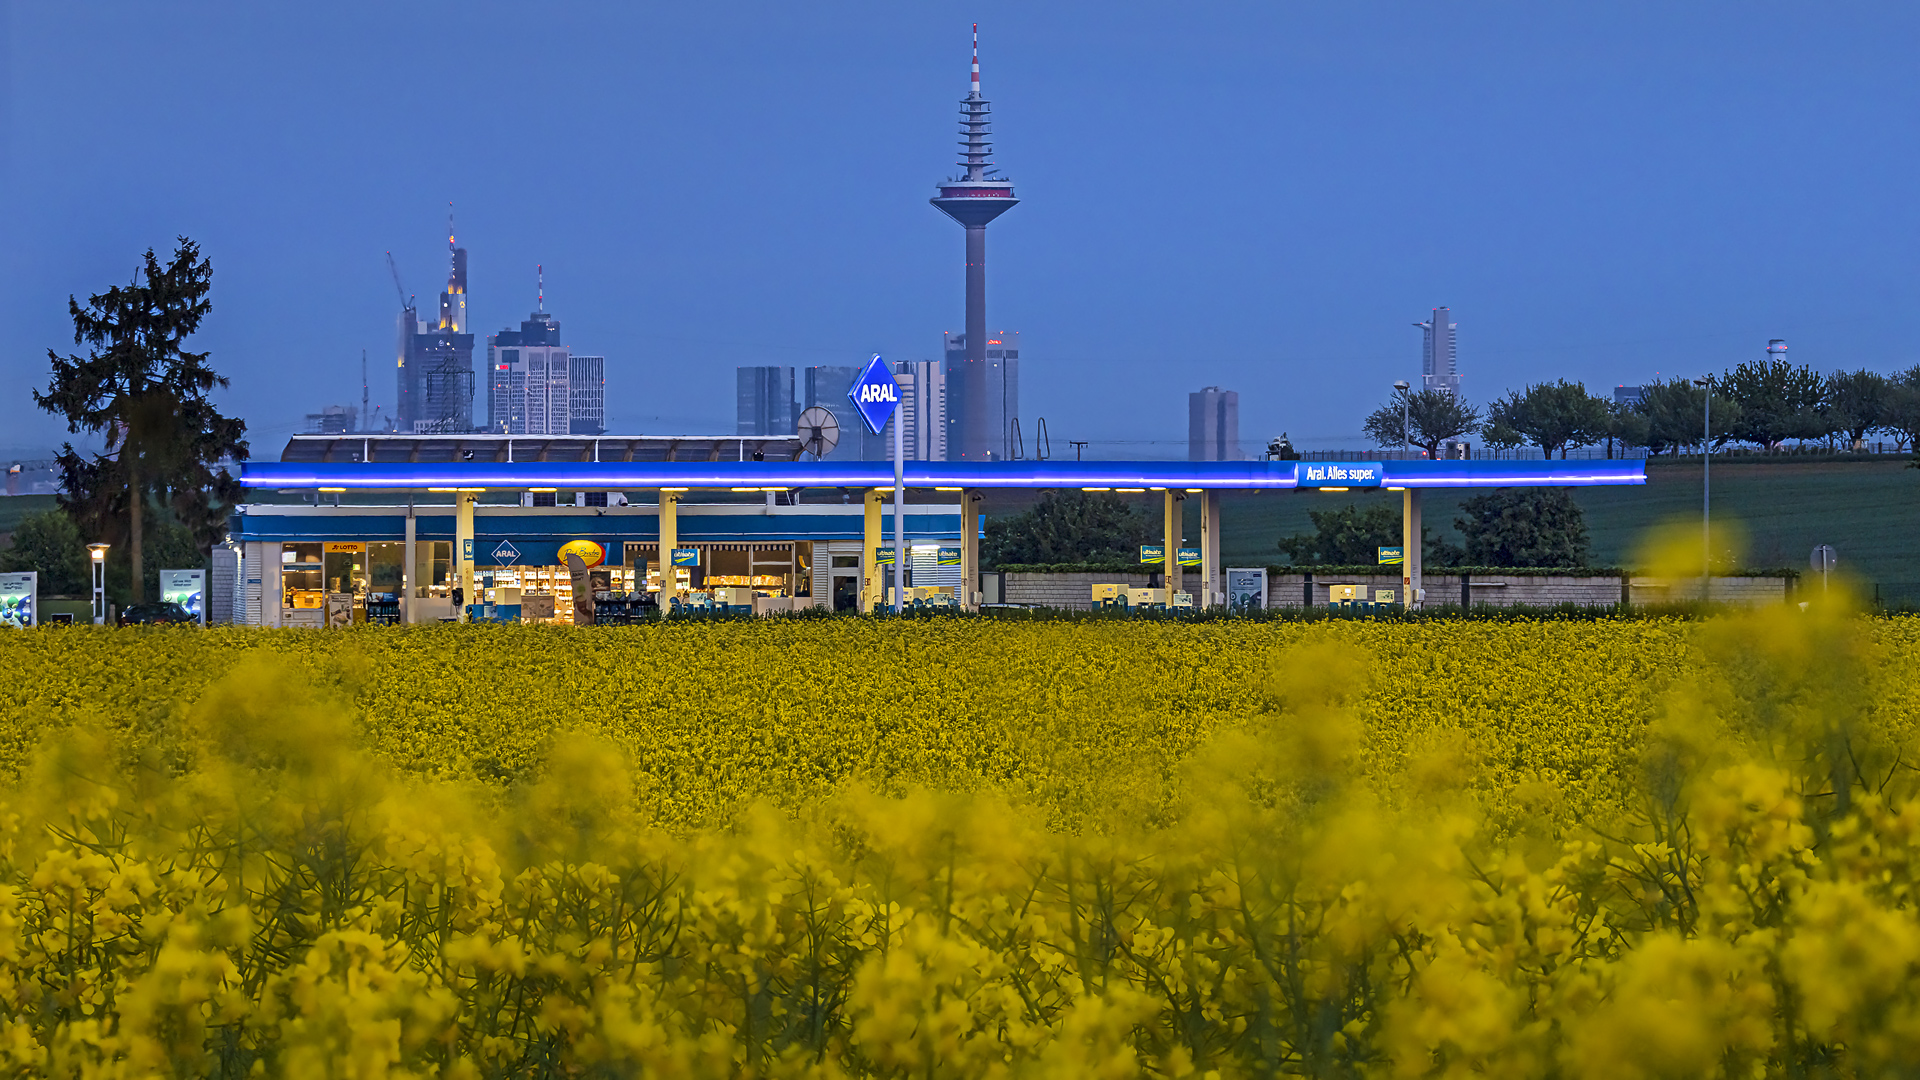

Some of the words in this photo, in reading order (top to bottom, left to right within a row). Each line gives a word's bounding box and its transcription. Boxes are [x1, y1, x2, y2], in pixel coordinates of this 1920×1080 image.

[860, 383, 898, 403] ARAL
[1306, 465, 1326, 481] Aral.
[1327, 465, 1347, 480] Alles
[1349, 469, 1375, 482] super.
